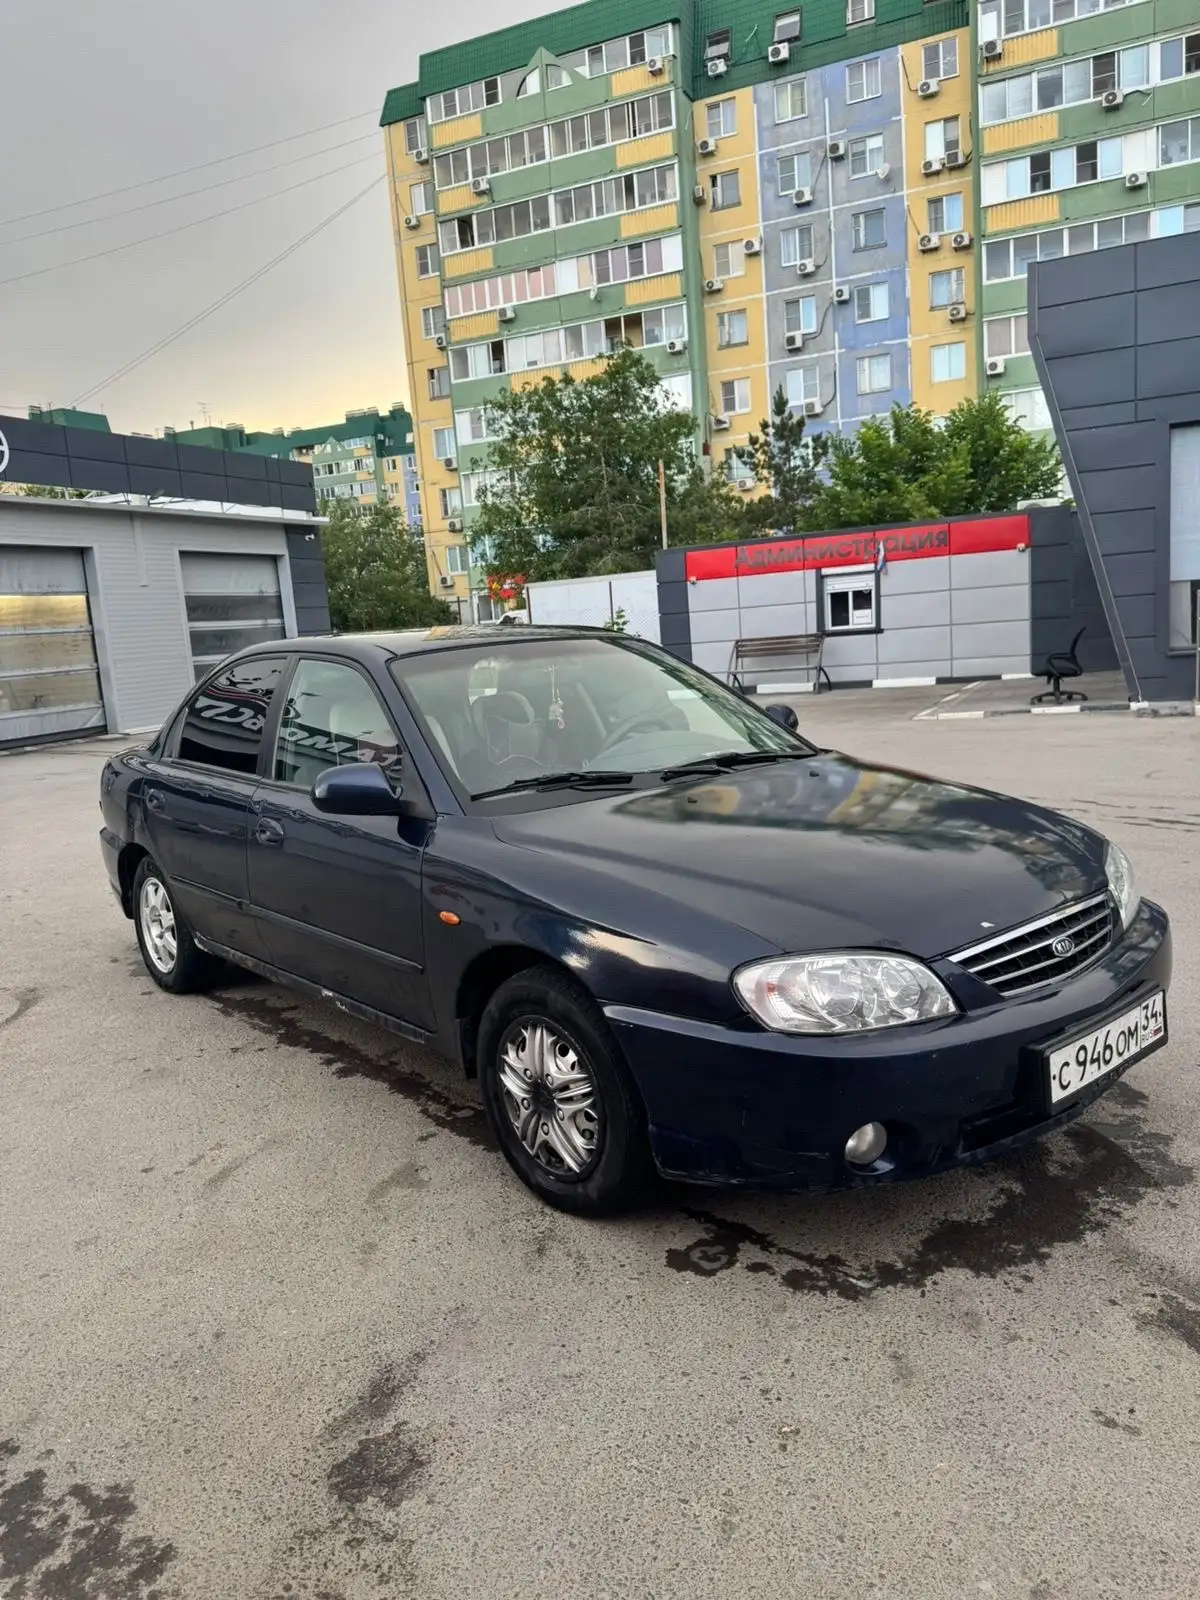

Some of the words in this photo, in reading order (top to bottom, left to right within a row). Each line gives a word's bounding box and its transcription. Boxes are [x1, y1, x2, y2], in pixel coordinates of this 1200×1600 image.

[736, 531, 948, 567] Администрация
[1054, 939, 1072, 954] KIA
[1142, 999, 1158, 1031] 34
